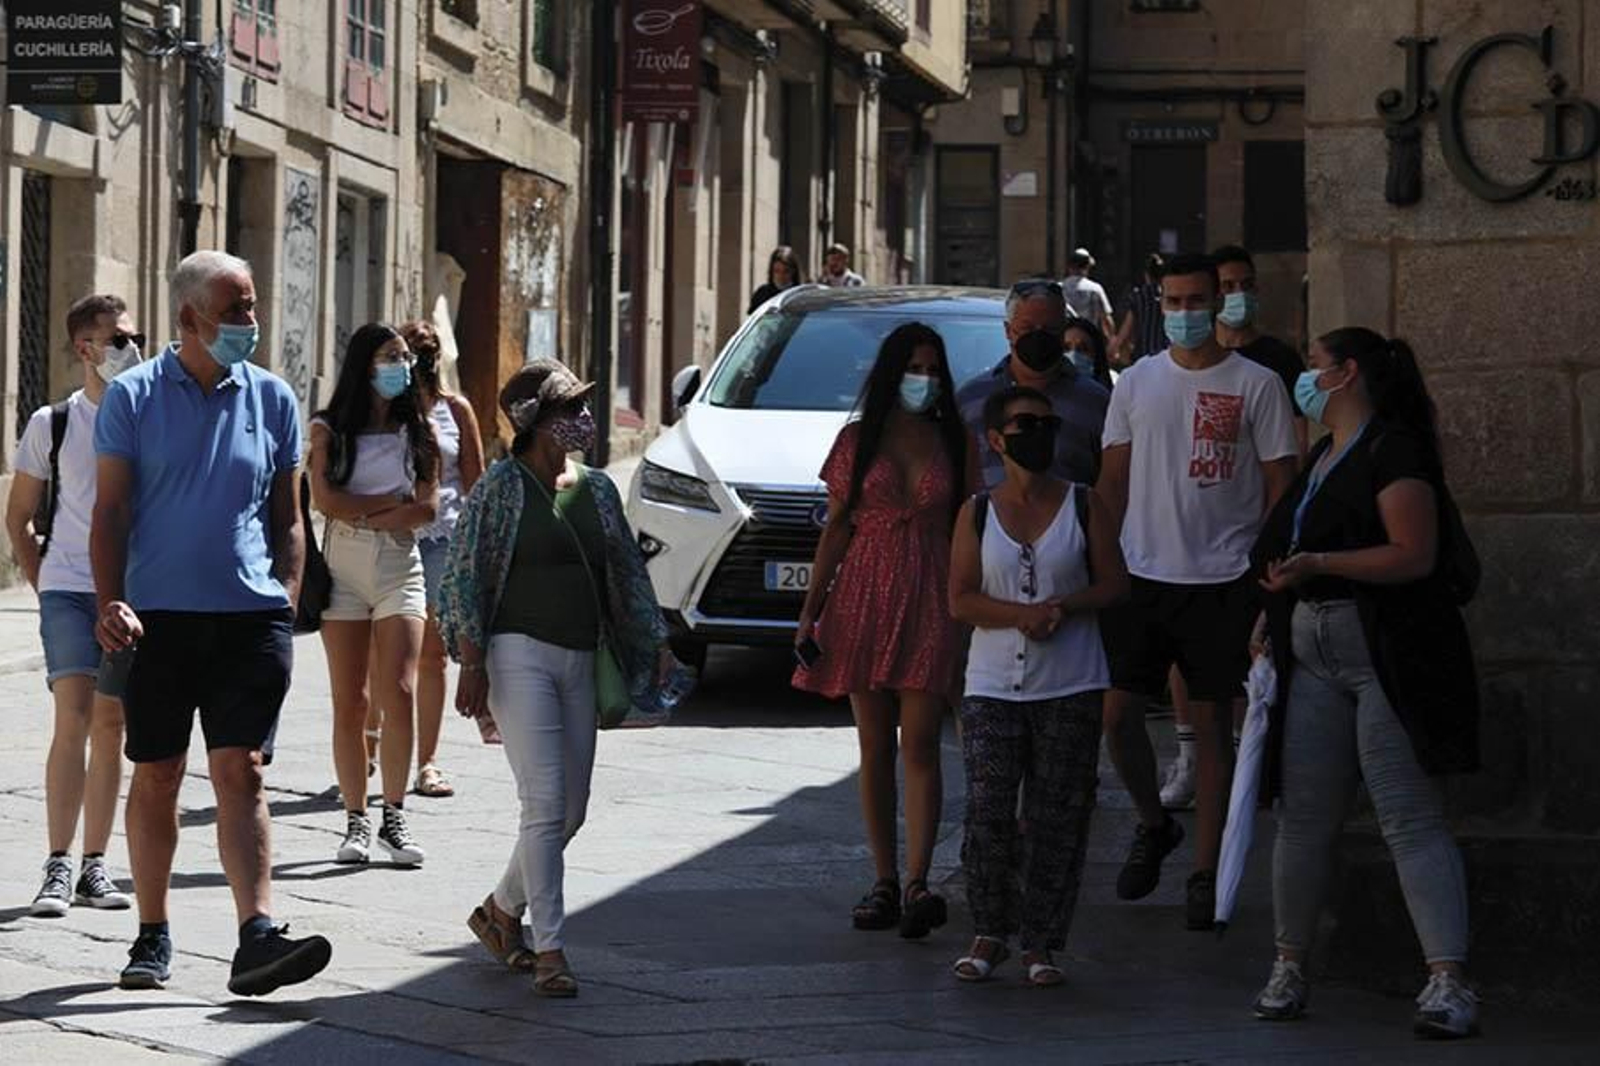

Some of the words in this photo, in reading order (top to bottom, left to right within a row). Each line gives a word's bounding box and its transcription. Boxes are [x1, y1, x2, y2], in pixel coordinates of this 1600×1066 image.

[15, 13, 114, 29] PARAGÜERÍA
[14, 40, 115, 57] CUCHILLERÍA
[1188, 459, 1218, 480] DO
